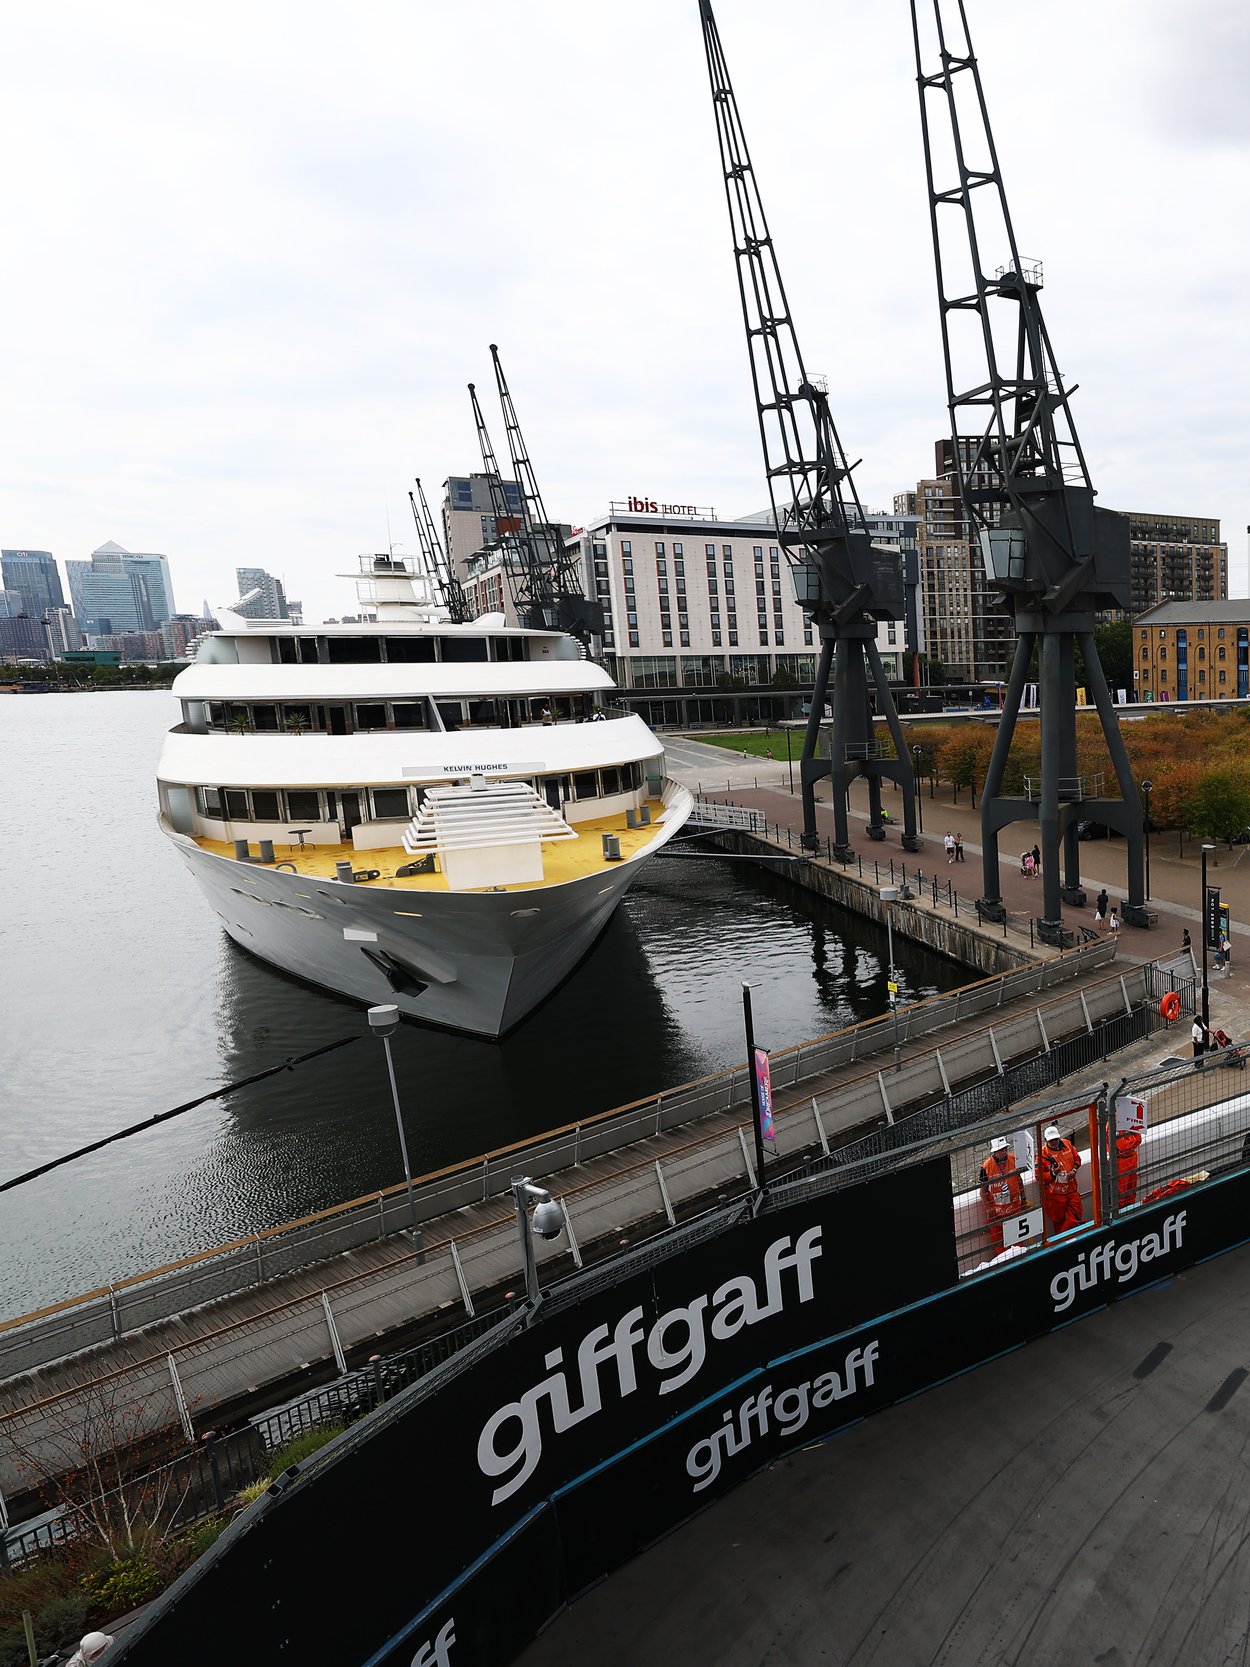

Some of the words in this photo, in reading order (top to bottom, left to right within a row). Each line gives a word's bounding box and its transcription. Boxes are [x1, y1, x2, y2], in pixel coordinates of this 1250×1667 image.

[628, 496, 658, 513] ibis
[664, 504, 700, 516] HOTEL
[1126, 1117, 1144, 1125] FIRE
[1018, 1218, 1030, 1238] 5
[1050, 1210, 1187, 1313] giffgaff
[477, 1225, 822, 1507] giffgaff
[686, 1340, 879, 1493] giffgaff
